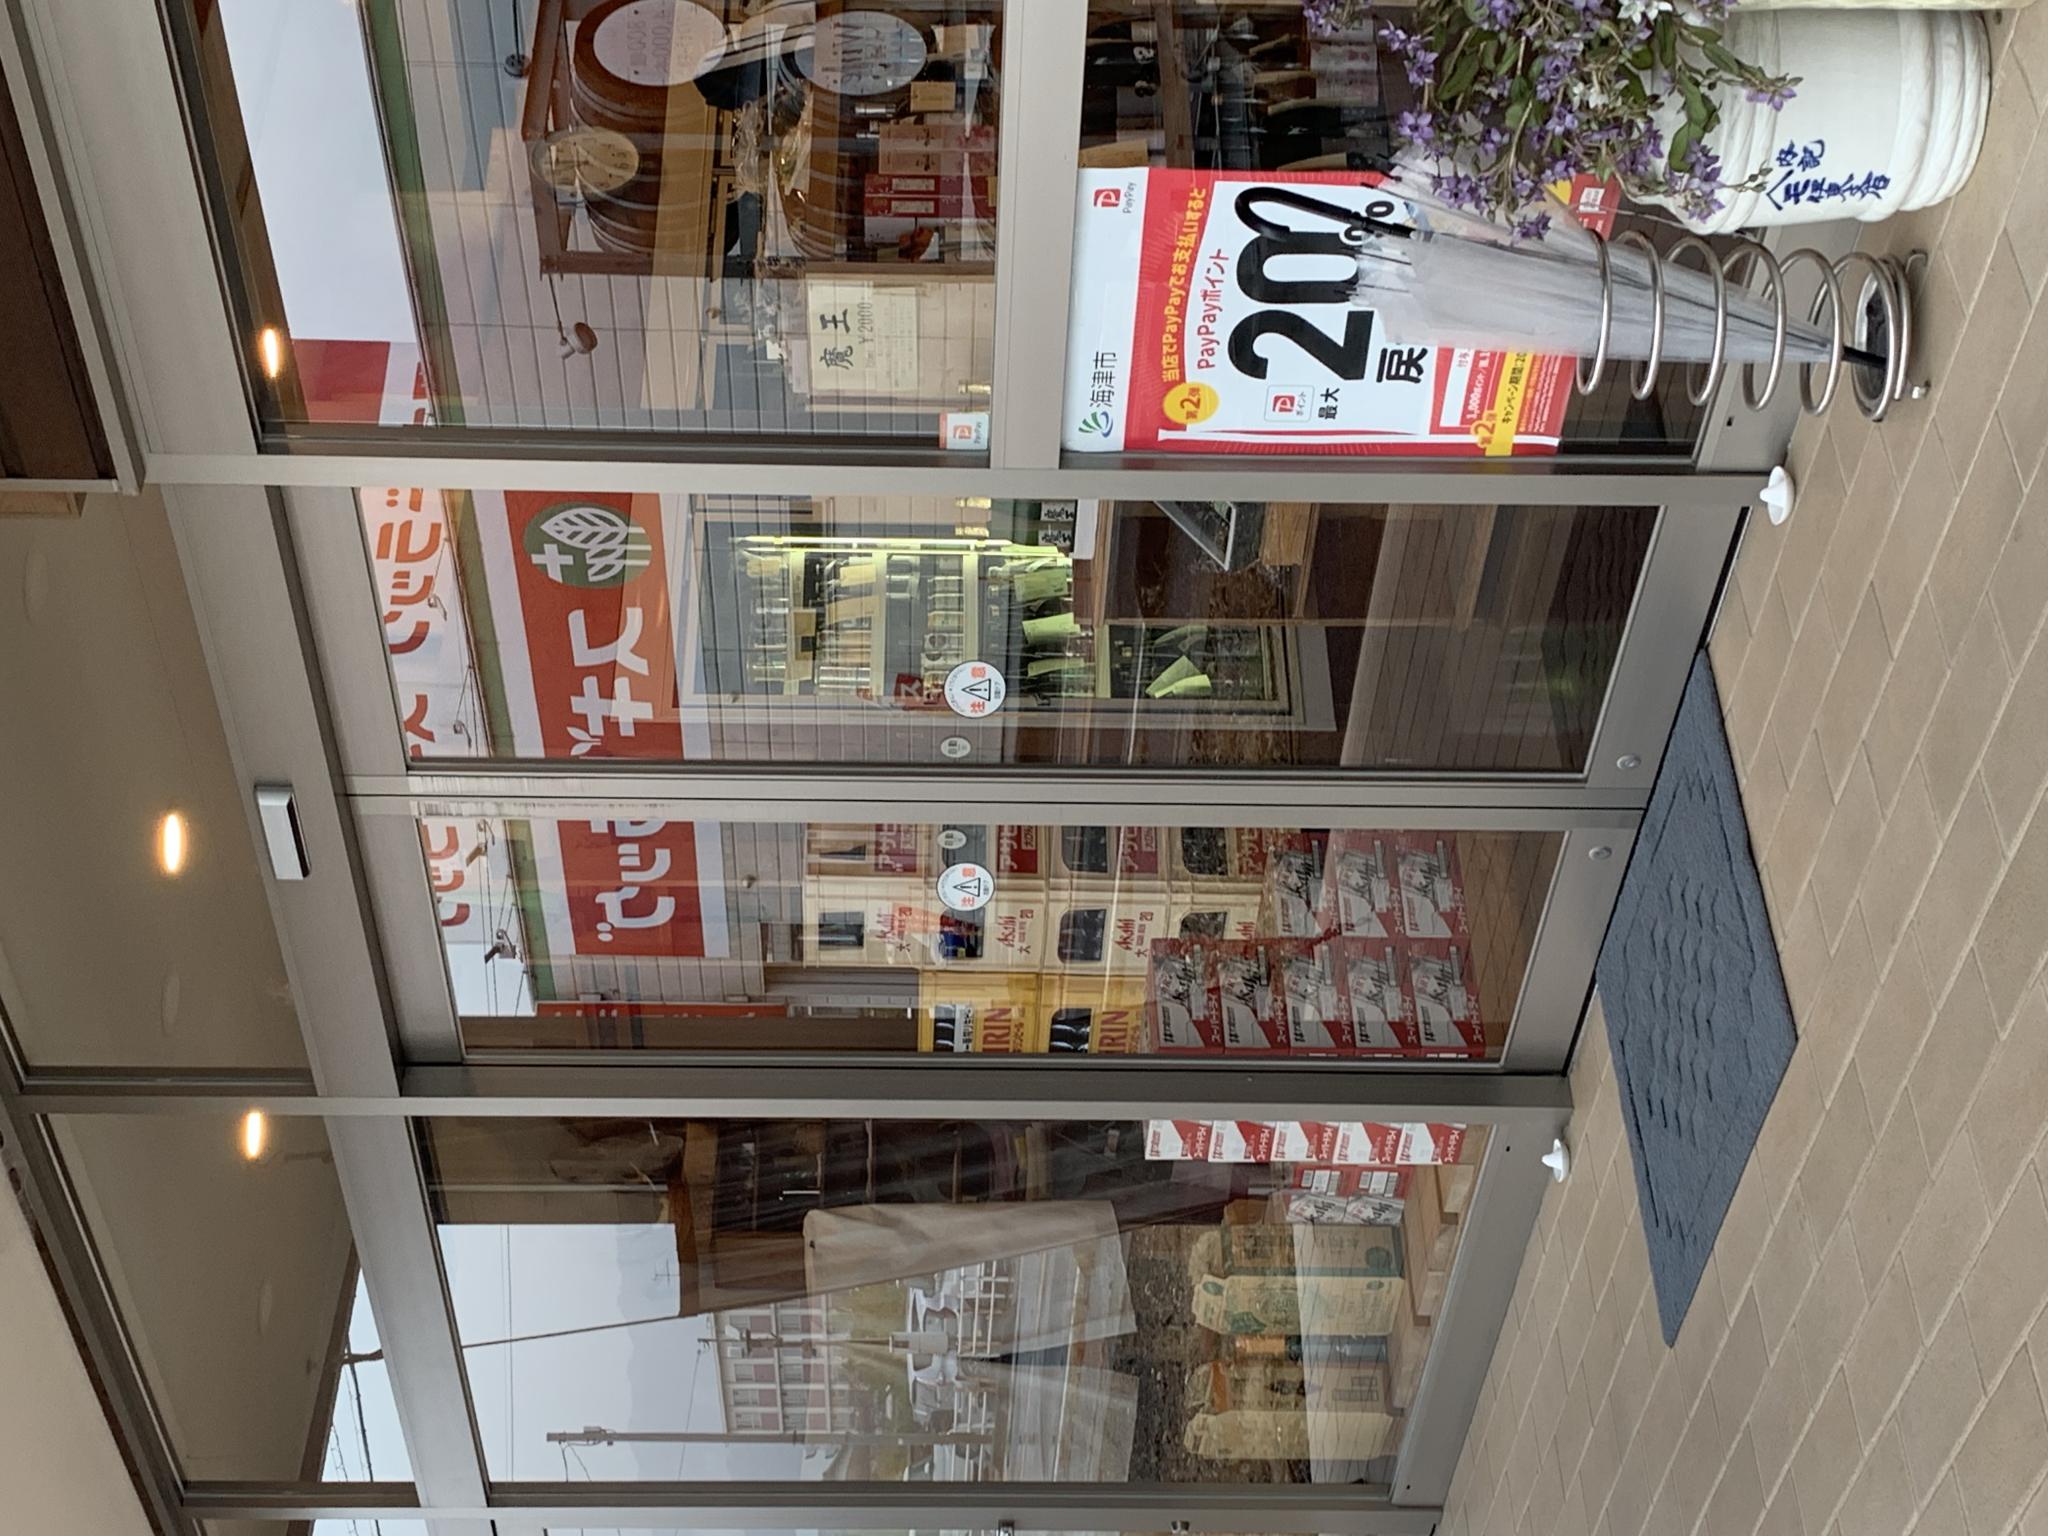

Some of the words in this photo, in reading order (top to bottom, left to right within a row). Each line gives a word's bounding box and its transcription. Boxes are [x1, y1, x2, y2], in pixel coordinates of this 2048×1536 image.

[1122, 181, 1137, 214] PayPay
[1197, 248, 1229, 370] PayPayポイント
[819, 308, 854, 370] 魔王
[1089, 351, 1117, 408] 海津市
[1376, 347, 1429, 384] 戻
[1318, 387, 1340, 420] 最大
[996, 916, 1016, 947] Asahi
[1113, 918, 1136, 951] Asahi
